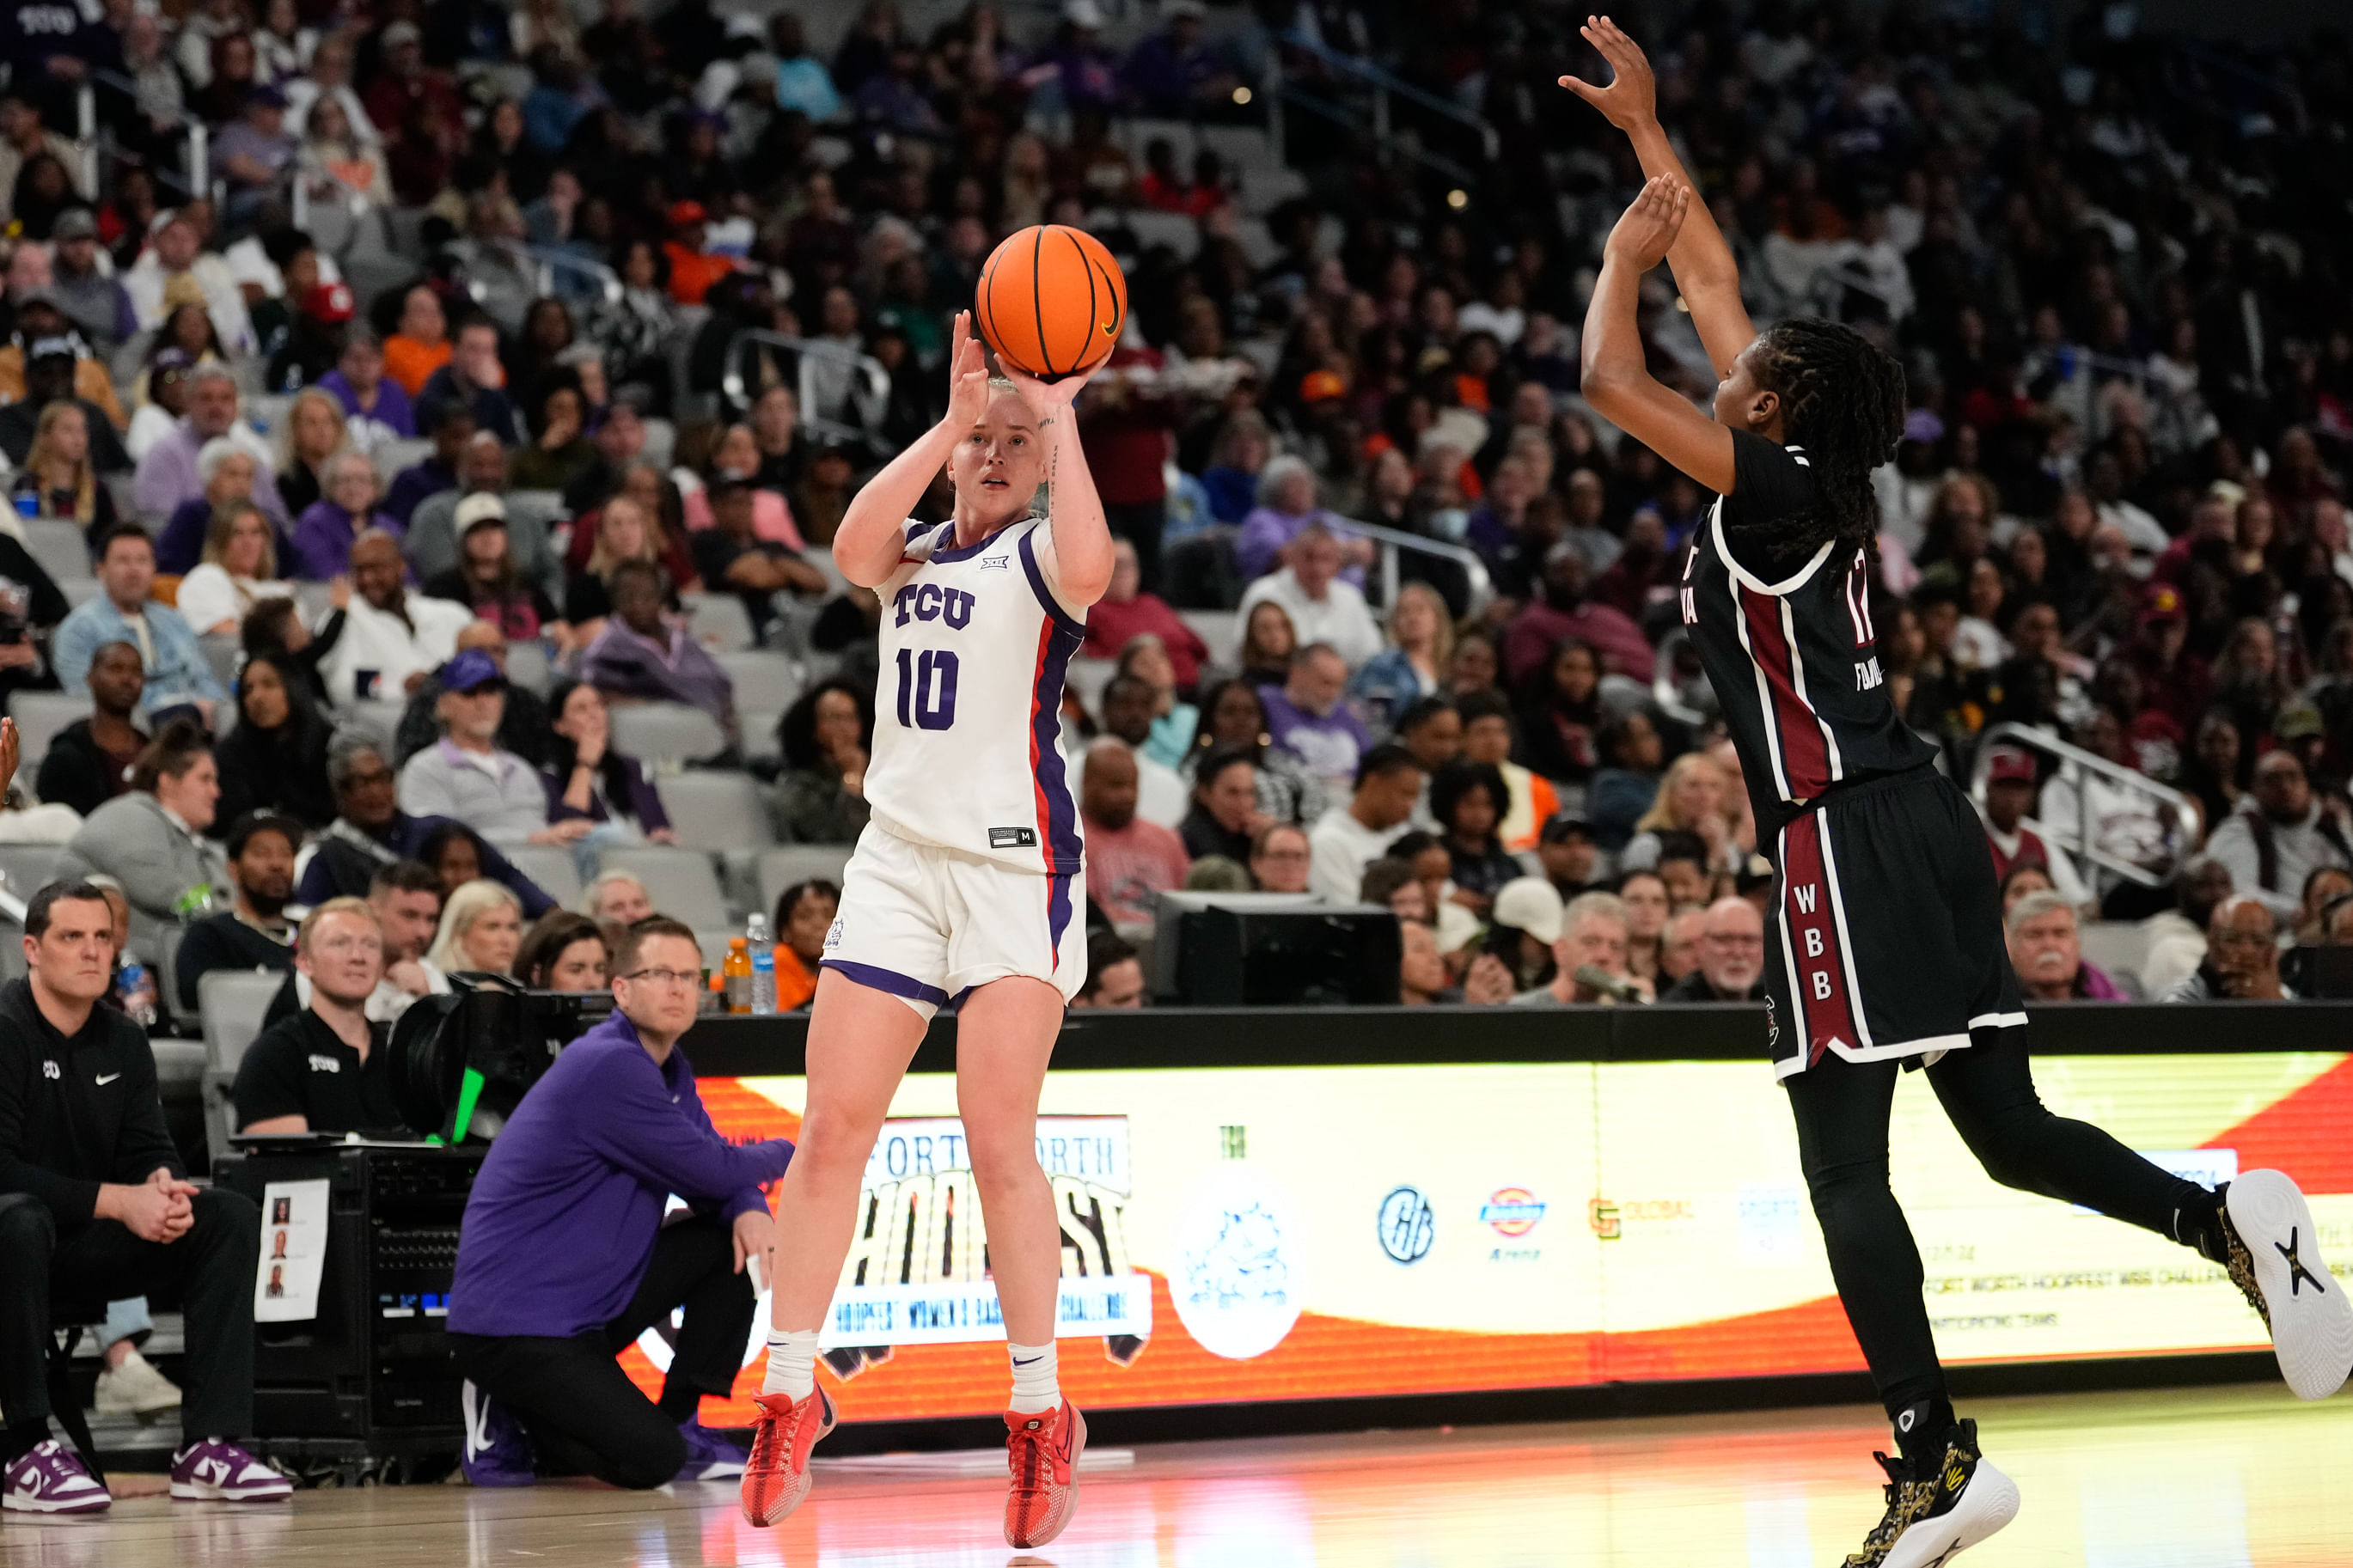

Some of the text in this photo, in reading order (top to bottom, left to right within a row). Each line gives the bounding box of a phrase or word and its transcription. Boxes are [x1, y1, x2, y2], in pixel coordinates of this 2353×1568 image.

[892, 583, 975, 631] TCU
[896, 648, 959, 731] 10
[1021, 832, 1030, 841] M
